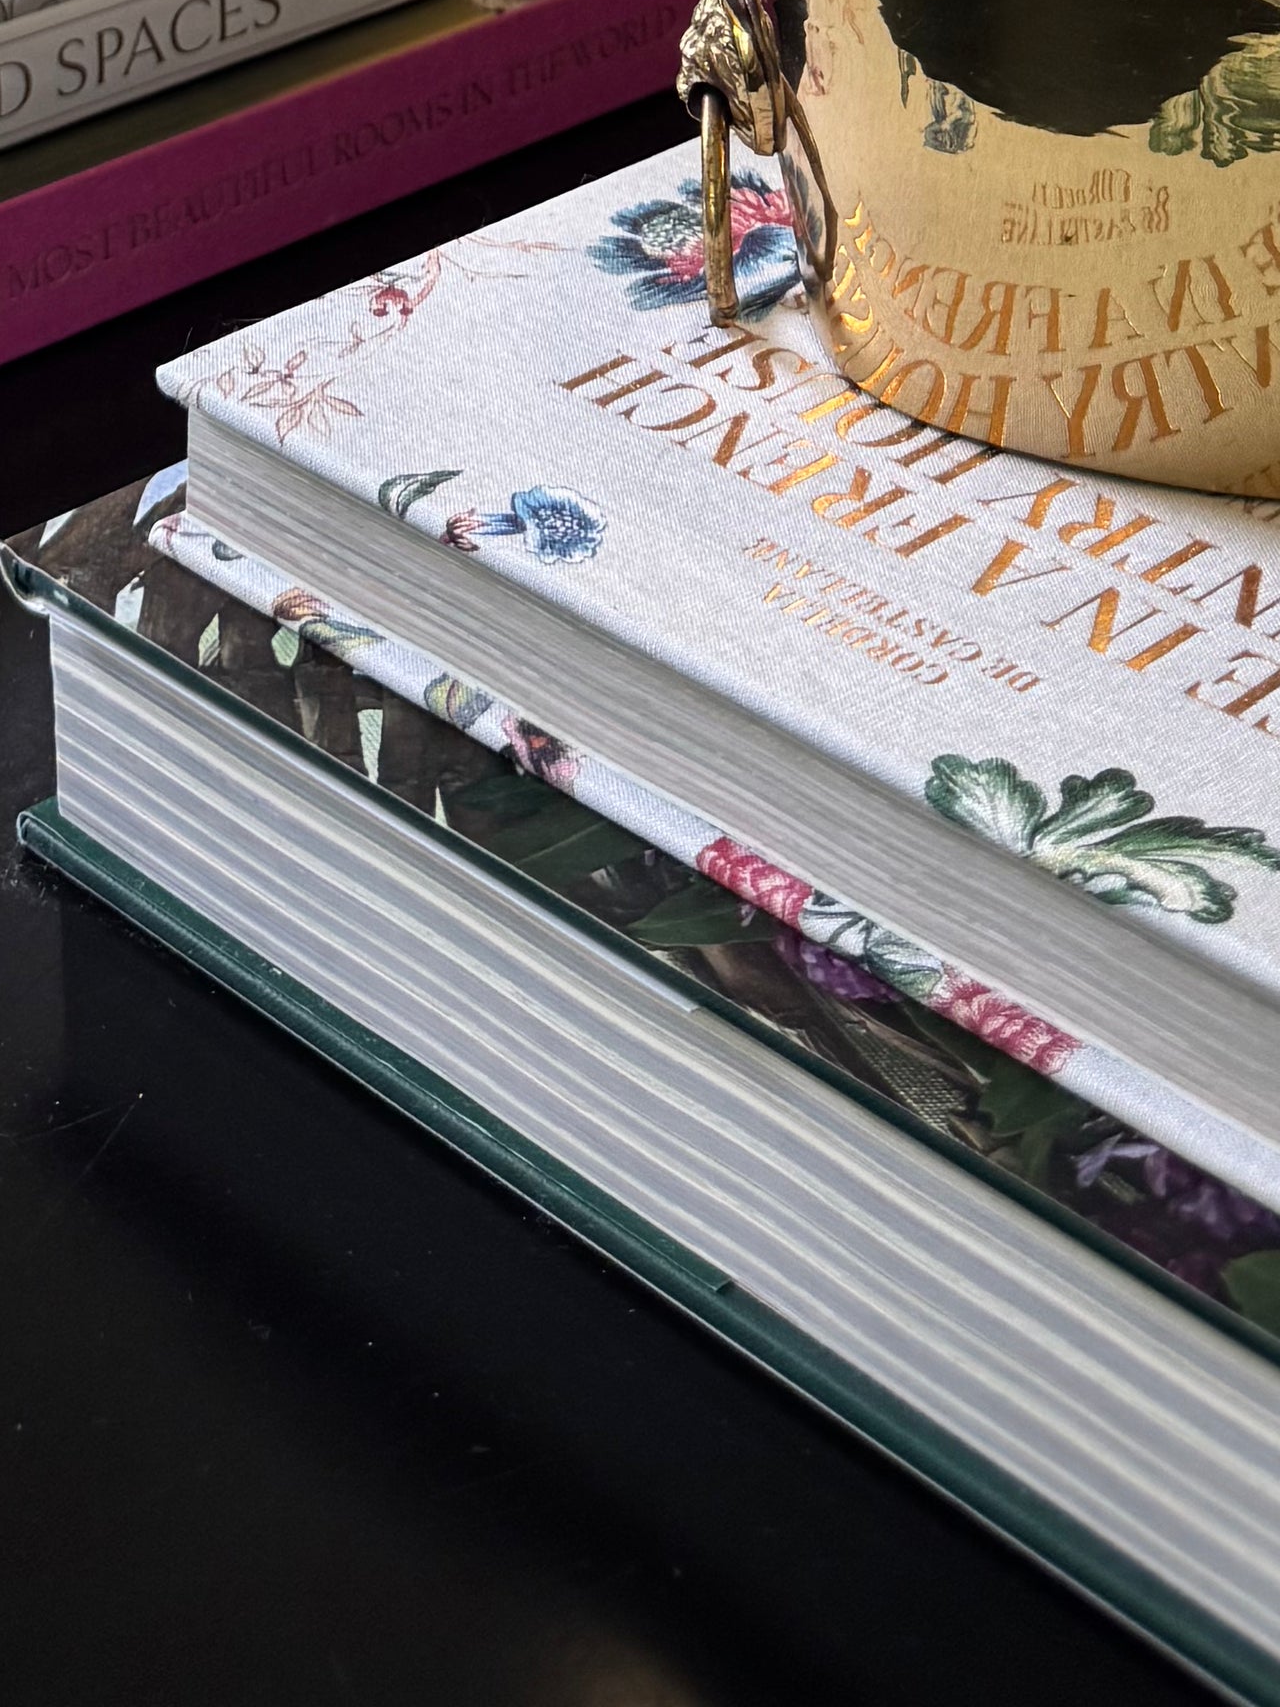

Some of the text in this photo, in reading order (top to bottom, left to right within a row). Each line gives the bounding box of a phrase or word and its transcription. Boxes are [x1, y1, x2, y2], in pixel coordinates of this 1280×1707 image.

[560, 354, 974, 557] FRENCH
[661, 324, 1006, 486] HOUSE
[743, 536, 1040, 694] DE CASTELLANE
[971, 538, 1074, 597] A
[1040, 586, 1207, 671] IN
[763, 582, 949, 685] CORDELIA
